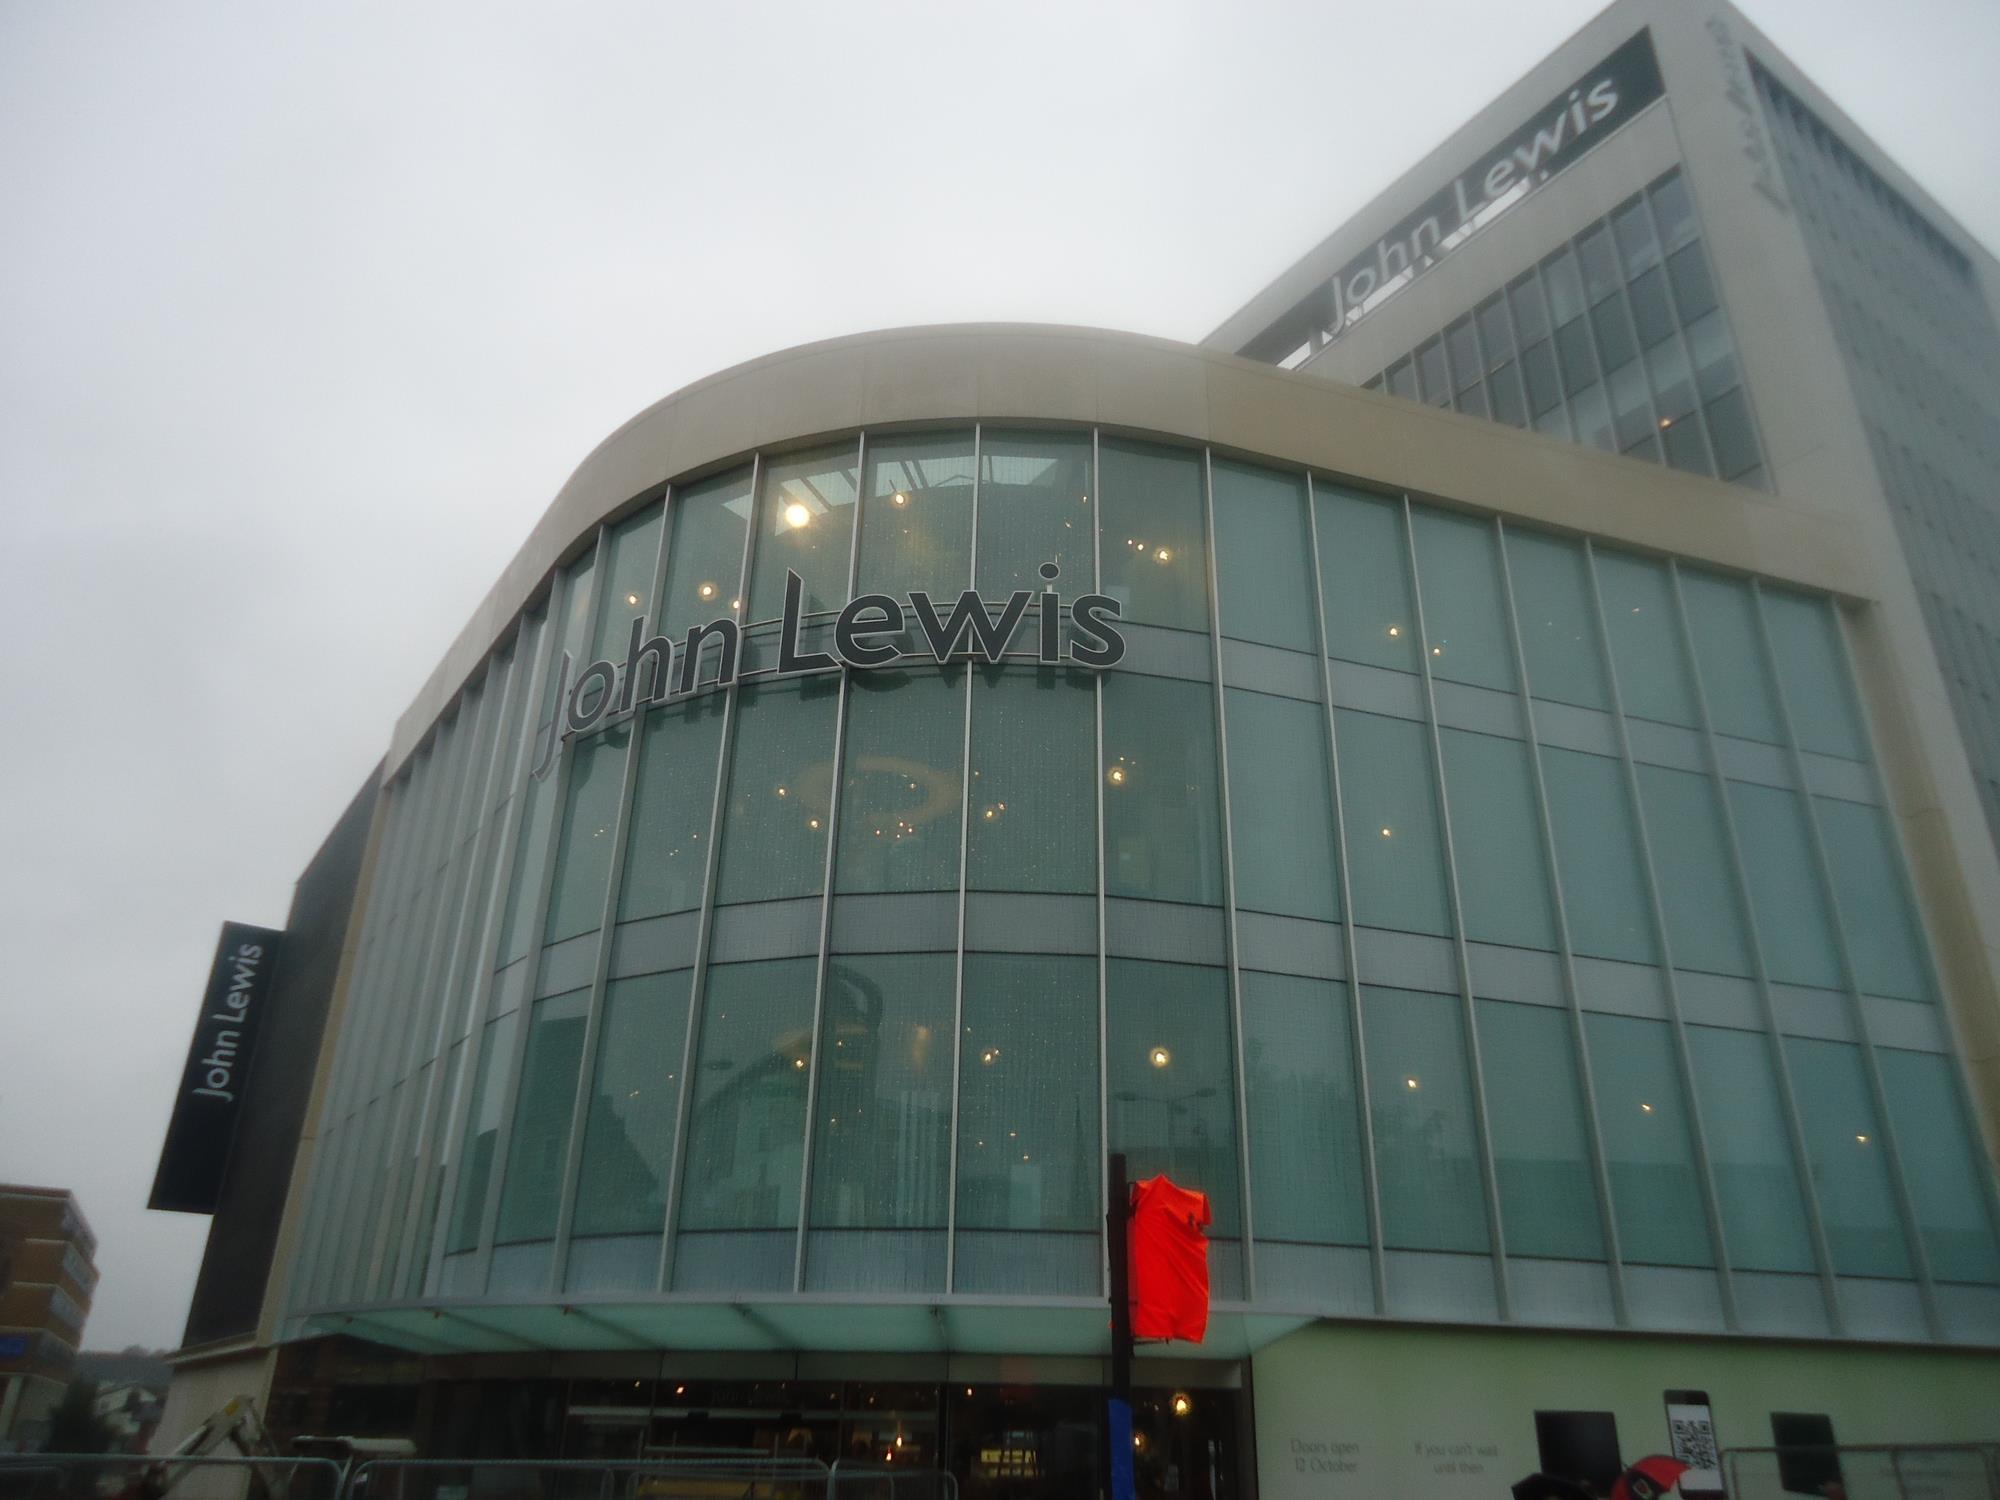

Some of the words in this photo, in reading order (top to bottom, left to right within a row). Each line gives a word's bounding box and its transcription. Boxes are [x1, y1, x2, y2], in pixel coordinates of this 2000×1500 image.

[1322, 215, 1442, 336] John
[1455, 76, 1620, 222] Lewis
[530, 615, 740, 780] John
[776, 562, 1127, 675] Lewis
[211, 942, 264, 1024] Lewis
[191, 1029, 242, 1102] John
[1290, 1437, 1327, 1454] Doors
[1331, 1441, 1360, 1457] open
[1310, 1457, 1359, 1473] October
